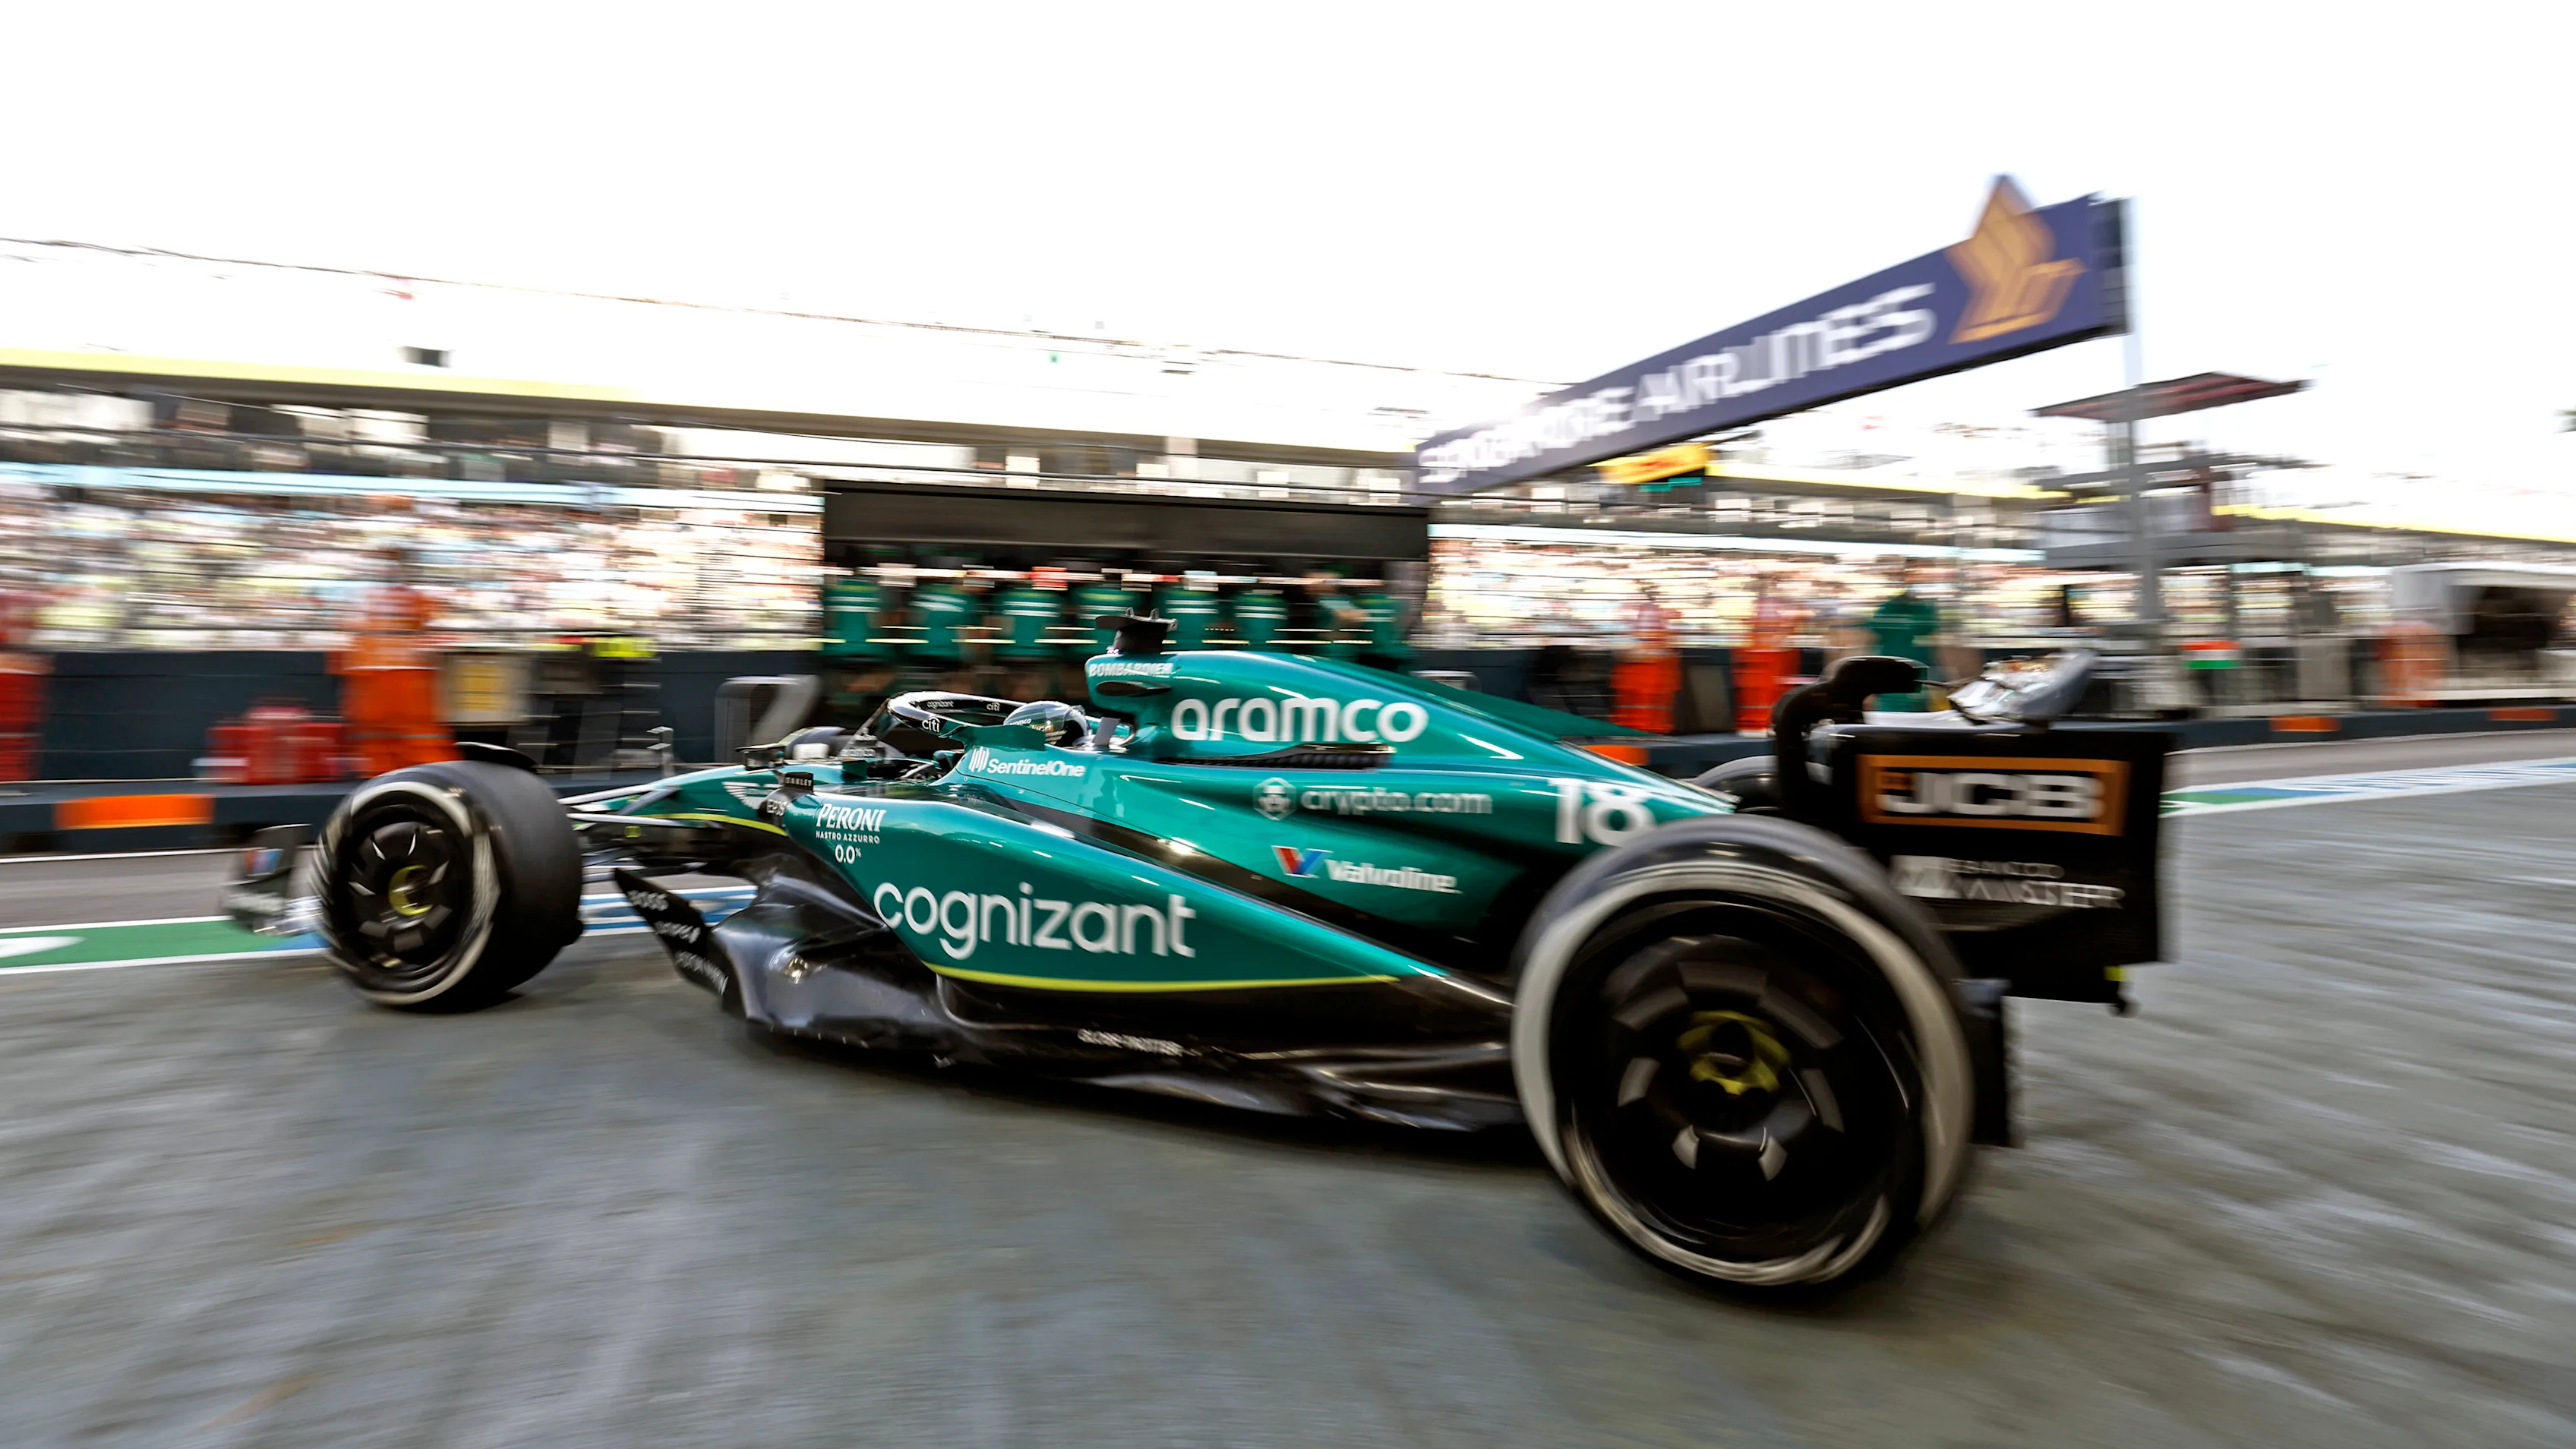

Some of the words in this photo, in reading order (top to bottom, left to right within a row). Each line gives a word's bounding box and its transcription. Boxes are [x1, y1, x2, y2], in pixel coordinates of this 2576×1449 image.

[1088, 662, 1174, 677] BOMBARDIER
[987, 702, 1000, 712] citi
[1171, 697, 1429, 742] aramco
[922, 716, 940, 732] citi
[987, 758, 1086, 777] SentinelOne
[1301, 786, 1493, 816] crypto.com
[1874, 771, 2106, 819] JCB
[816, 803, 887, 832] PERONI
[1547, 777, 1657, 848] 18
[816, 830, 841, 841] NASTRO
[843, 833, 880, 844] AZZURRO
[1324, 859, 1463, 894] Valvoline
[873, 881, 1197, 960] cognizant
